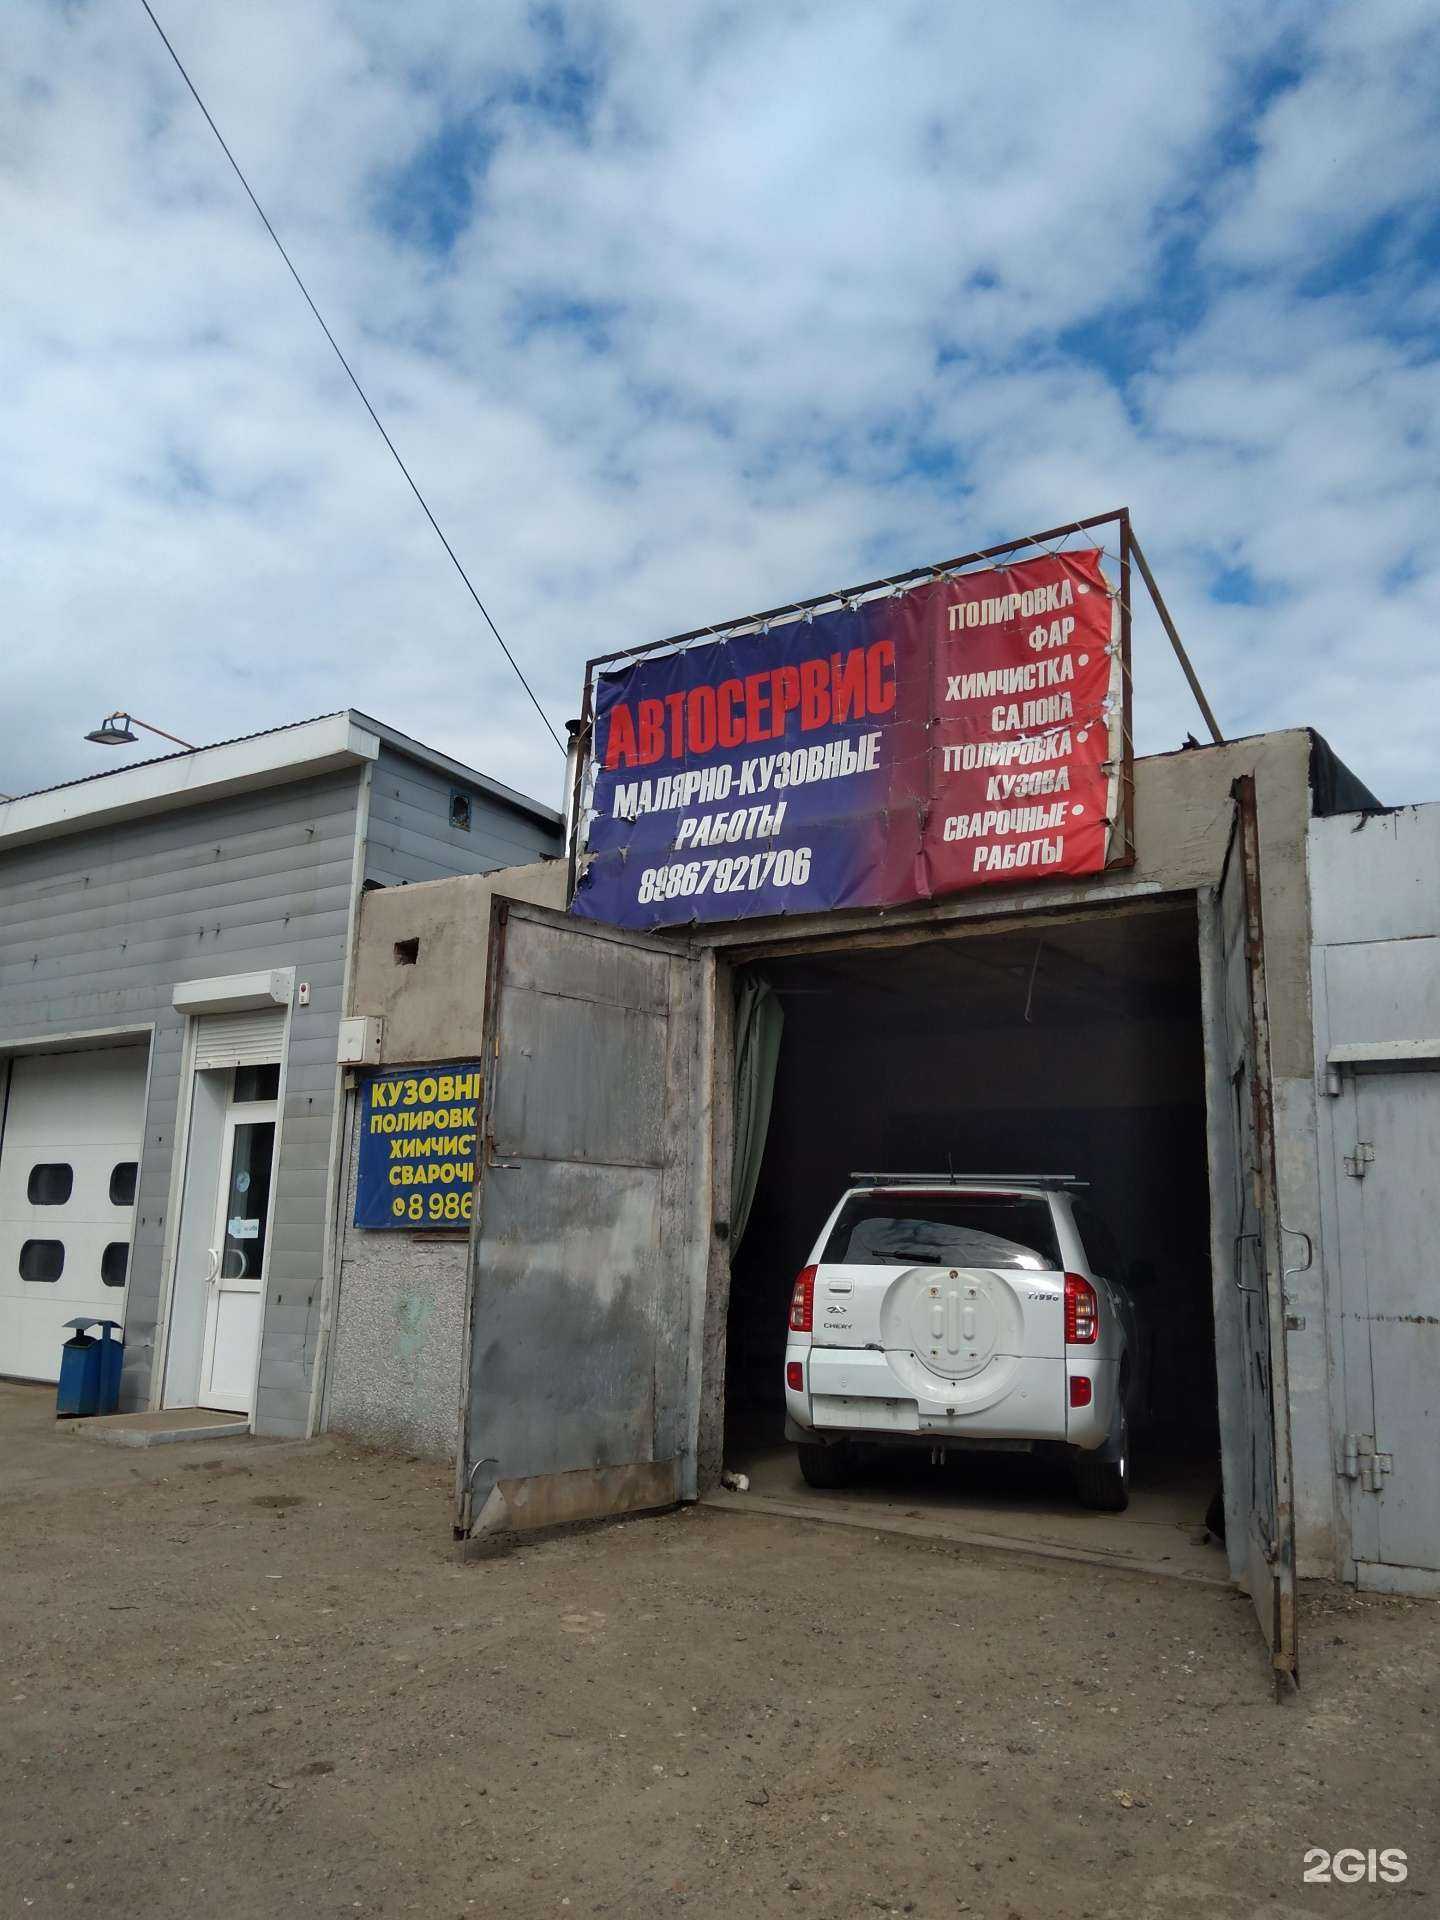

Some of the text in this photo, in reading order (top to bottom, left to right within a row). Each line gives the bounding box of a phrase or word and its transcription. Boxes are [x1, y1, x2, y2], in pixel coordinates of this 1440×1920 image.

[948, 579, 1074, 632] ПОЛИРОВКА
[1028, 616, 1075, 652] ФАР
[945, 654, 1074, 702] ХИМЧИСТКА
[606, 641, 896, 770] АВТОСЕРВИС
[991, 691, 1074, 732] САЛОНА
[943, 730, 1073, 772] ПОЛИРОВКА
[612, 732, 882, 818] МАЛЯРНО-КУЗОВНЫЕ
[986, 766, 1070, 801] КУЗОВА
[674, 802, 787, 850] РАБОТЫ
[943, 801, 1069, 842] СВАРОЧНЫЕ
[972, 836, 1064, 872] РАБОТЫ
[638, 847, 812, 904] 89867921706
[370, 1106, 477, 1134] ПОЛИРОВК
[389, 1135, 476, 1159] ХИМЧИС
